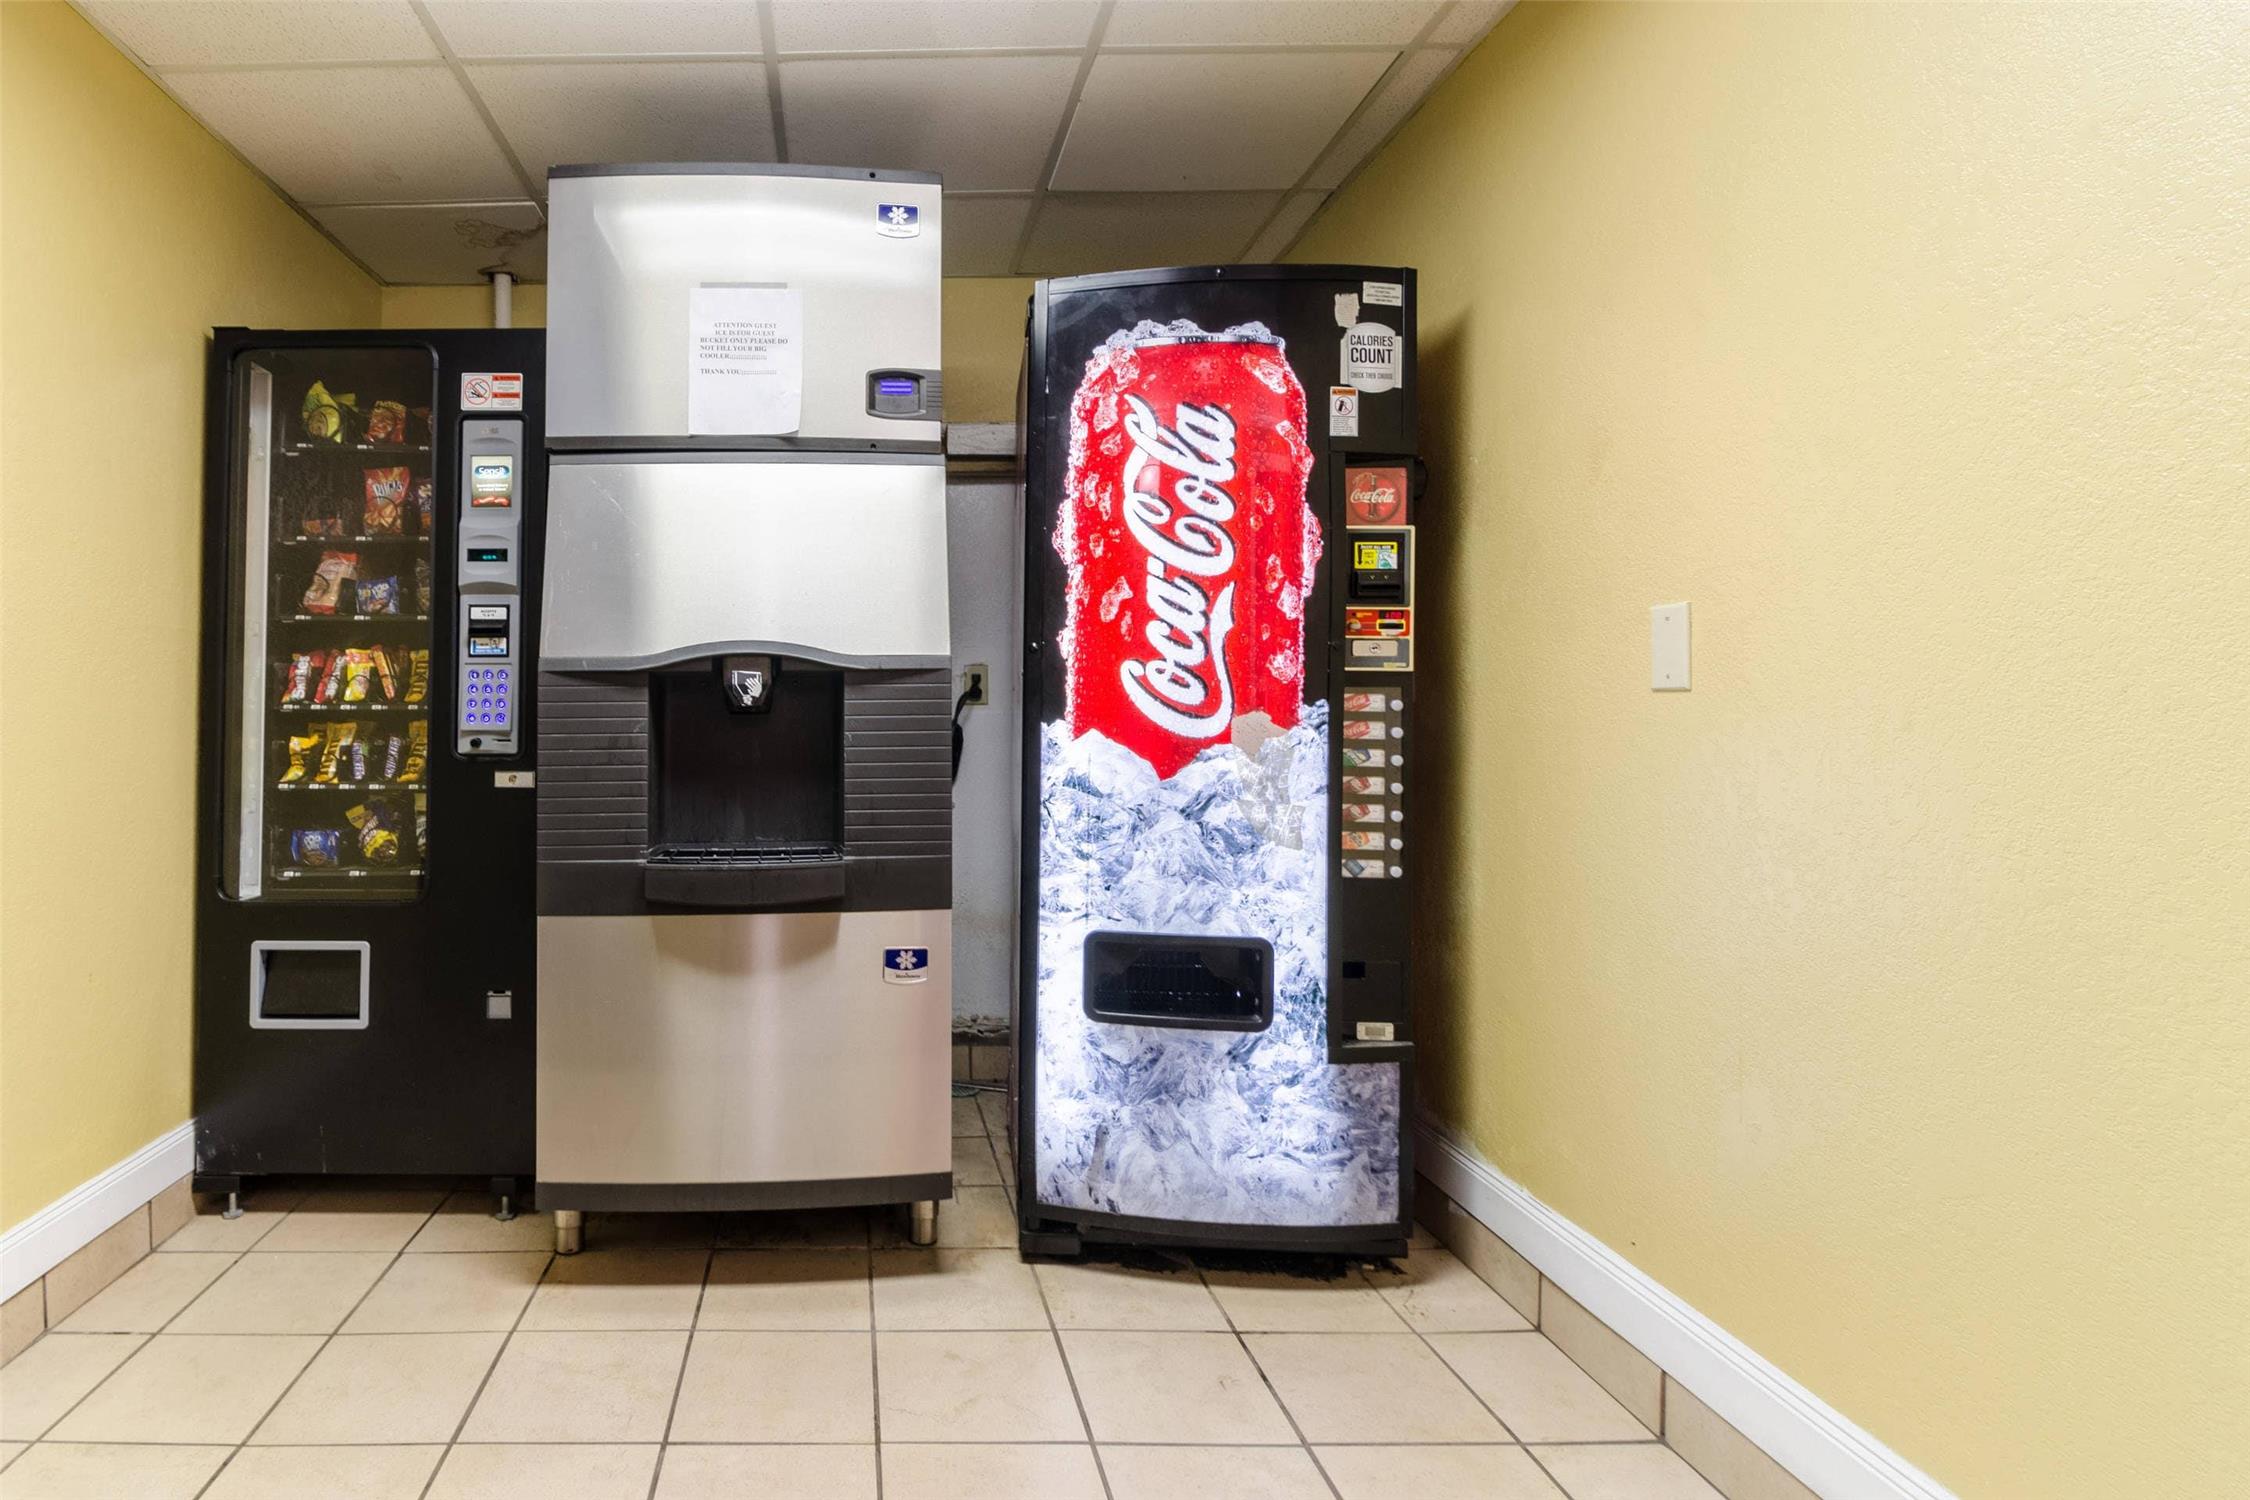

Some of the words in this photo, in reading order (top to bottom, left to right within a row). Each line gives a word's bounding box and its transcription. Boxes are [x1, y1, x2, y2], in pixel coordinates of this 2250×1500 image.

[1351, 334, 1394, 347] CALORIES
[1350, 347, 1393, 364] COUNT
[1350, 488, 1396, 503] Coca-Cola
[1119, 393, 1239, 738] Coca-Cola
